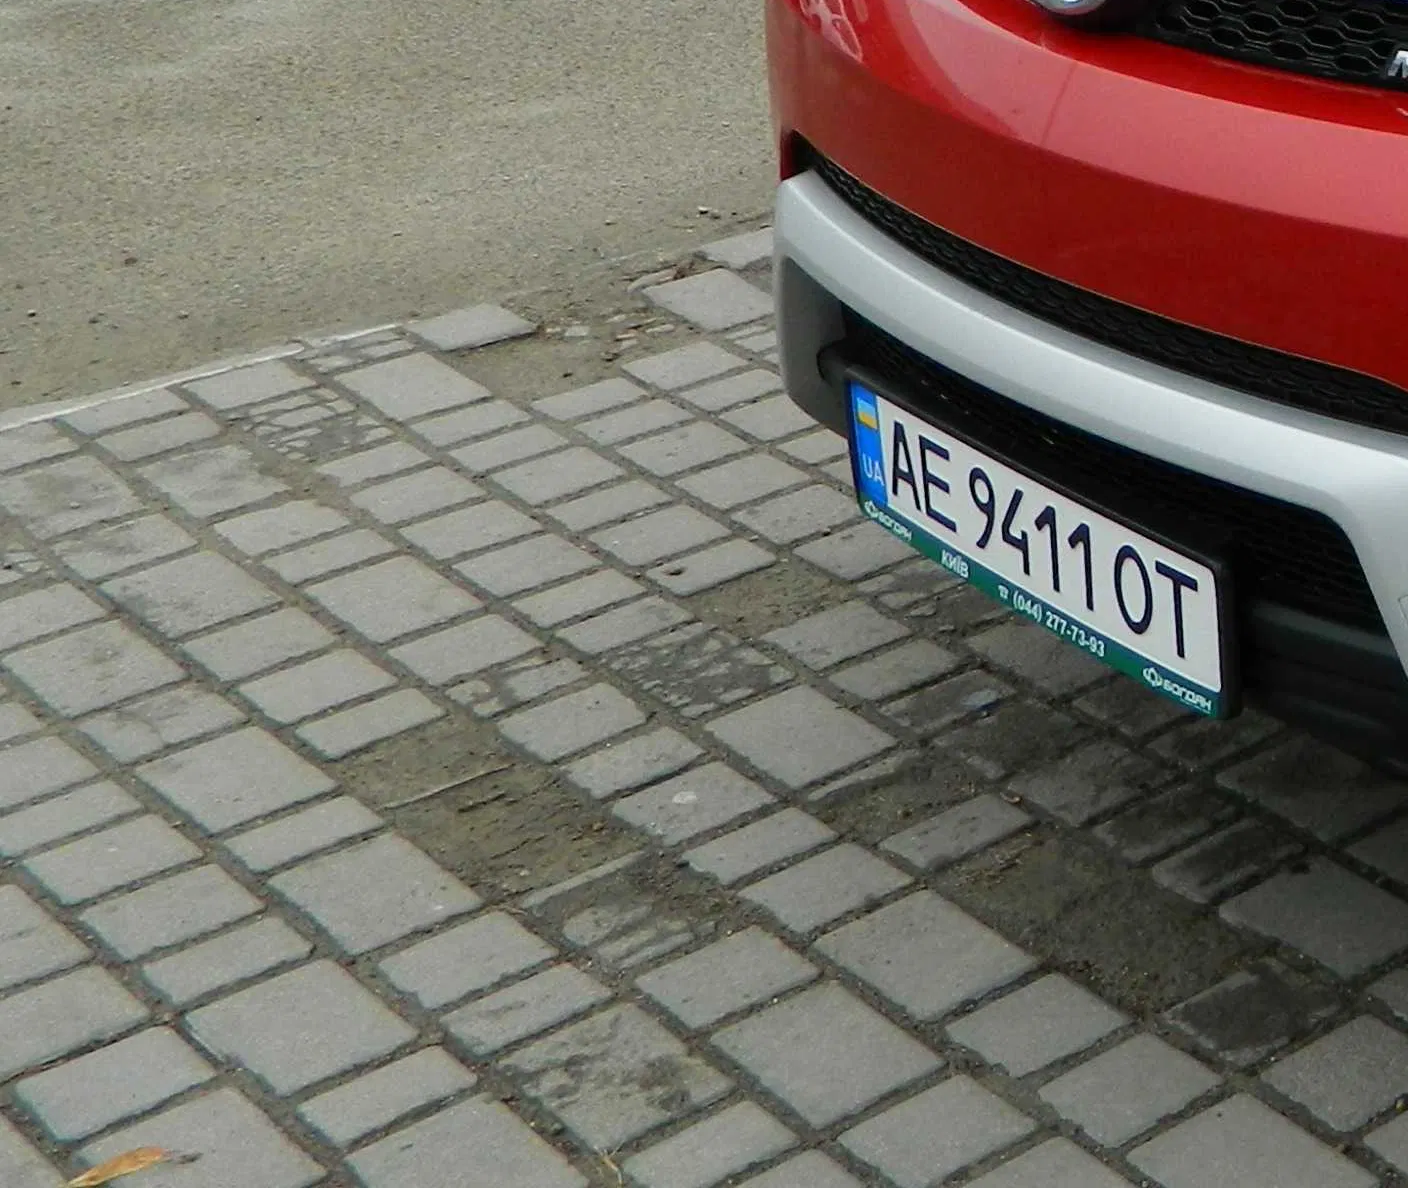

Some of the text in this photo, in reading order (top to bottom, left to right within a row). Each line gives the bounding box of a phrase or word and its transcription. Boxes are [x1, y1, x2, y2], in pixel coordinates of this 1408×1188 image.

[862, 452, 885, 487] UA
[892, 420, 1199, 659] AE 9411 OT
[941, 549, 969, 579] КИЇВ
[1012, 589, 1106, 658] (044) 277-73-93
